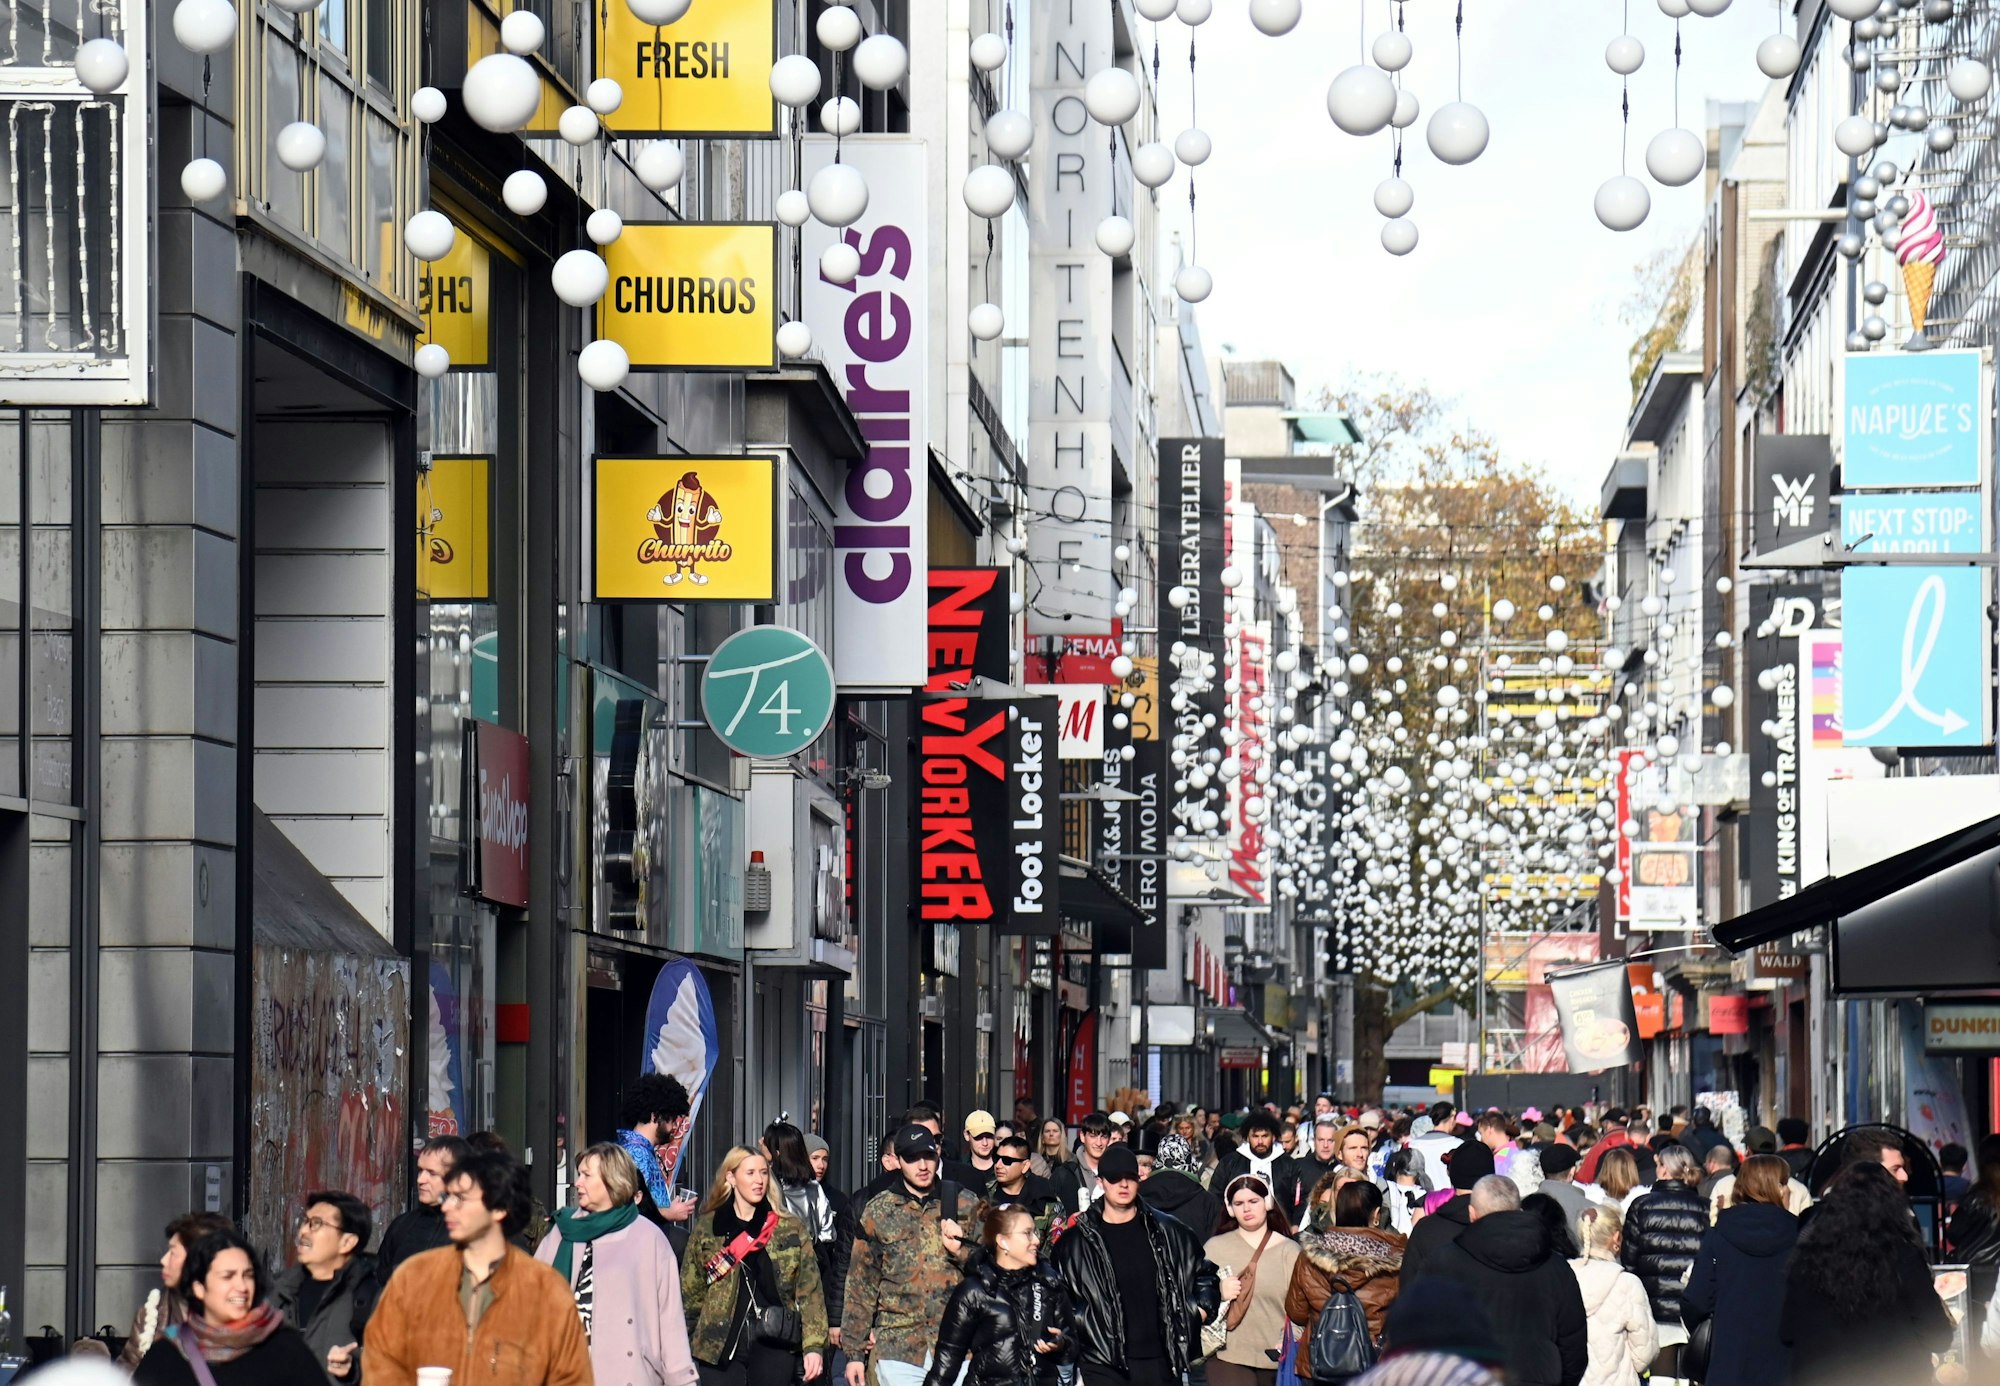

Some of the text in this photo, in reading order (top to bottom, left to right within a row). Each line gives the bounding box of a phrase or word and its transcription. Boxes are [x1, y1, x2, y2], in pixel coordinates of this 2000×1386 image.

[637, 41, 729, 79] FRESH
[615, 276, 756, 314] CHURROS
[1771, 473, 1816, 527] WMF
[1849, 506, 1975, 536] NEXT STOP:
[638, 538, 732, 563] Churrito
[1181, 443, 1201, 637] LEDERATELIER
[1777, 662, 1797, 875] KING OF TRAINERS
[480, 768, 528, 871] EuroShop
[1013, 716, 1043, 914] Foot Locker
[1103, 748, 1122, 890] ACK&JONES
[1139, 773, 1157, 852] MODA
[1760, 955, 1802, 968] WALD
[1931, 1017, 2000, 1034] DUNKI
